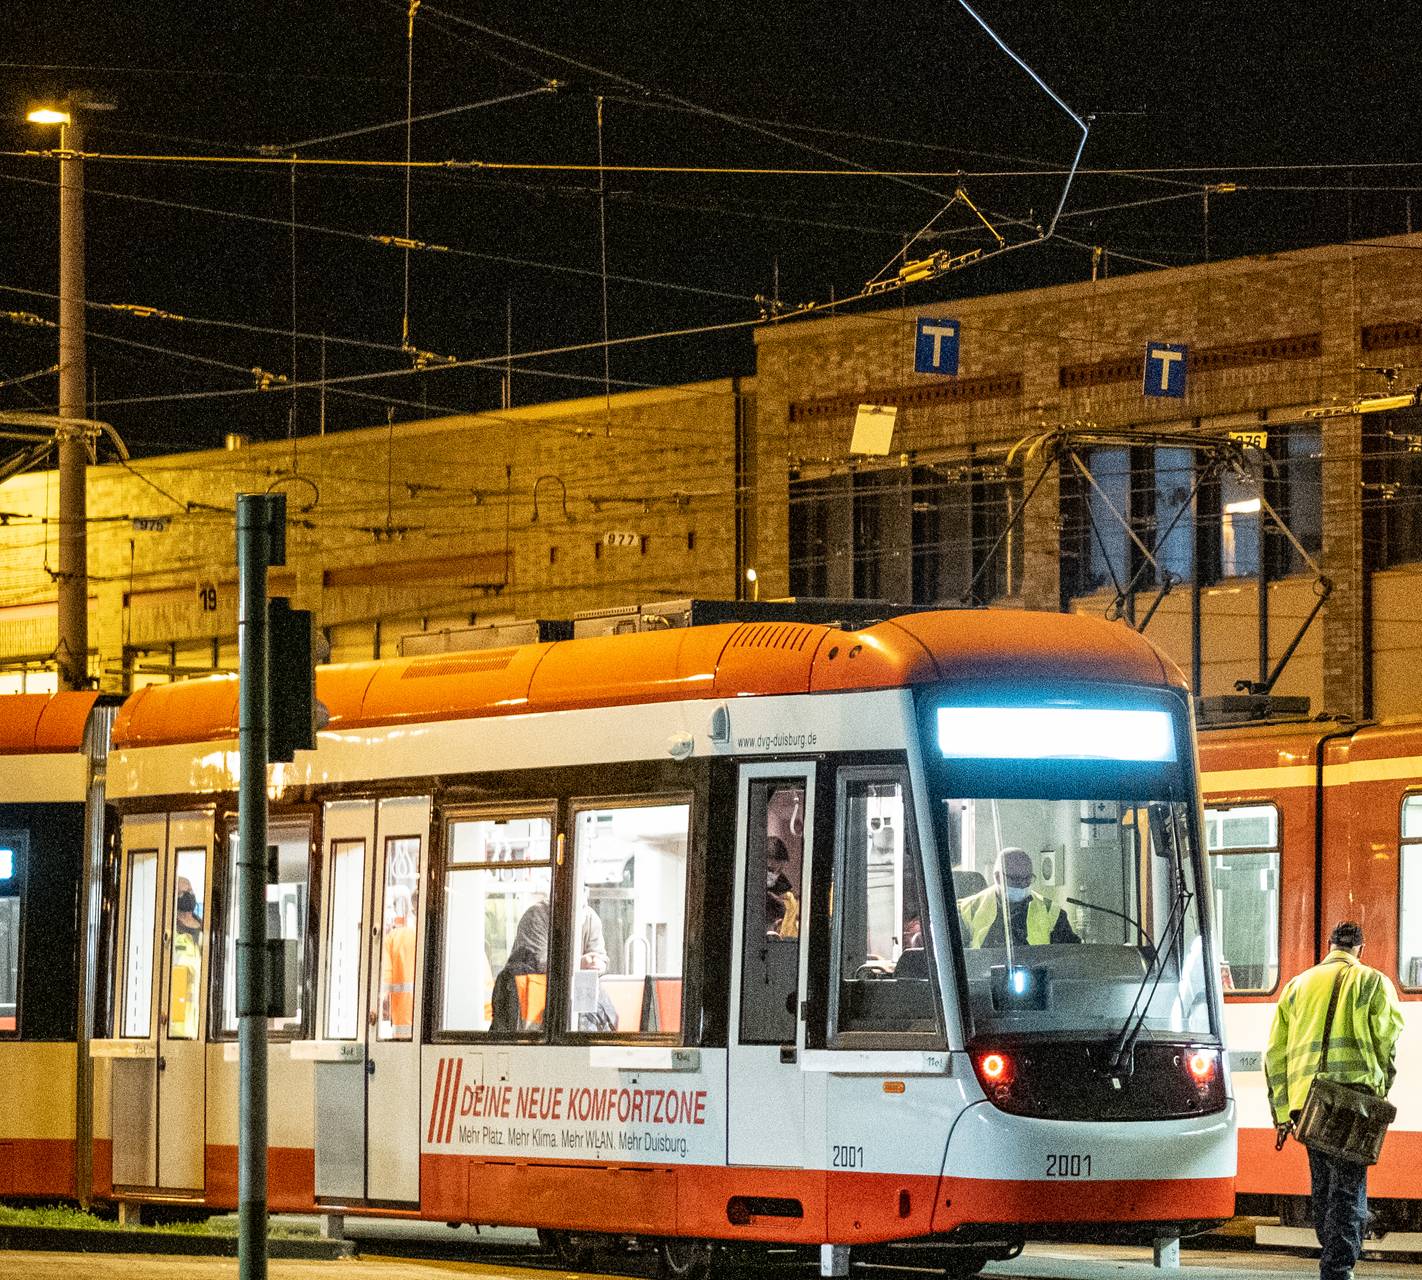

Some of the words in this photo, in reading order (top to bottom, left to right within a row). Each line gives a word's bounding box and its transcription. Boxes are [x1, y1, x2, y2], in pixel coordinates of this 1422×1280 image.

[922, 325, 954, 367] T
[1151, 350, 1182, 390] T
[608, 534, 635, 545] 977
[200, 588, 217, 610] 19
[737, 731, 817, 750] www.dvg-duisburg.de
[460, 1084, 513, 1118] DEINE
[515, 1086, 564, 1120] NEUE
[567, 1087, 708, 1125] KOMFORTZONE
[459, 1125, 480, 1144] Mehr
[482, 1126, 505, 1146] Platz.
[508, 1127, 530, 1146] Mehr
[532, 1128, 559, 1148] Klima.
[561, 1129, 584, 1149] Mehr
[585, 1130, 615, 1150] WLAN.
[618, 1131, 642, 1151] Mehr
[644, 1132, 689, 1158] Duisburg.
[832, 1145, 864, 1168] 2001
[1046, 1154, 1092, 1177] 2001
